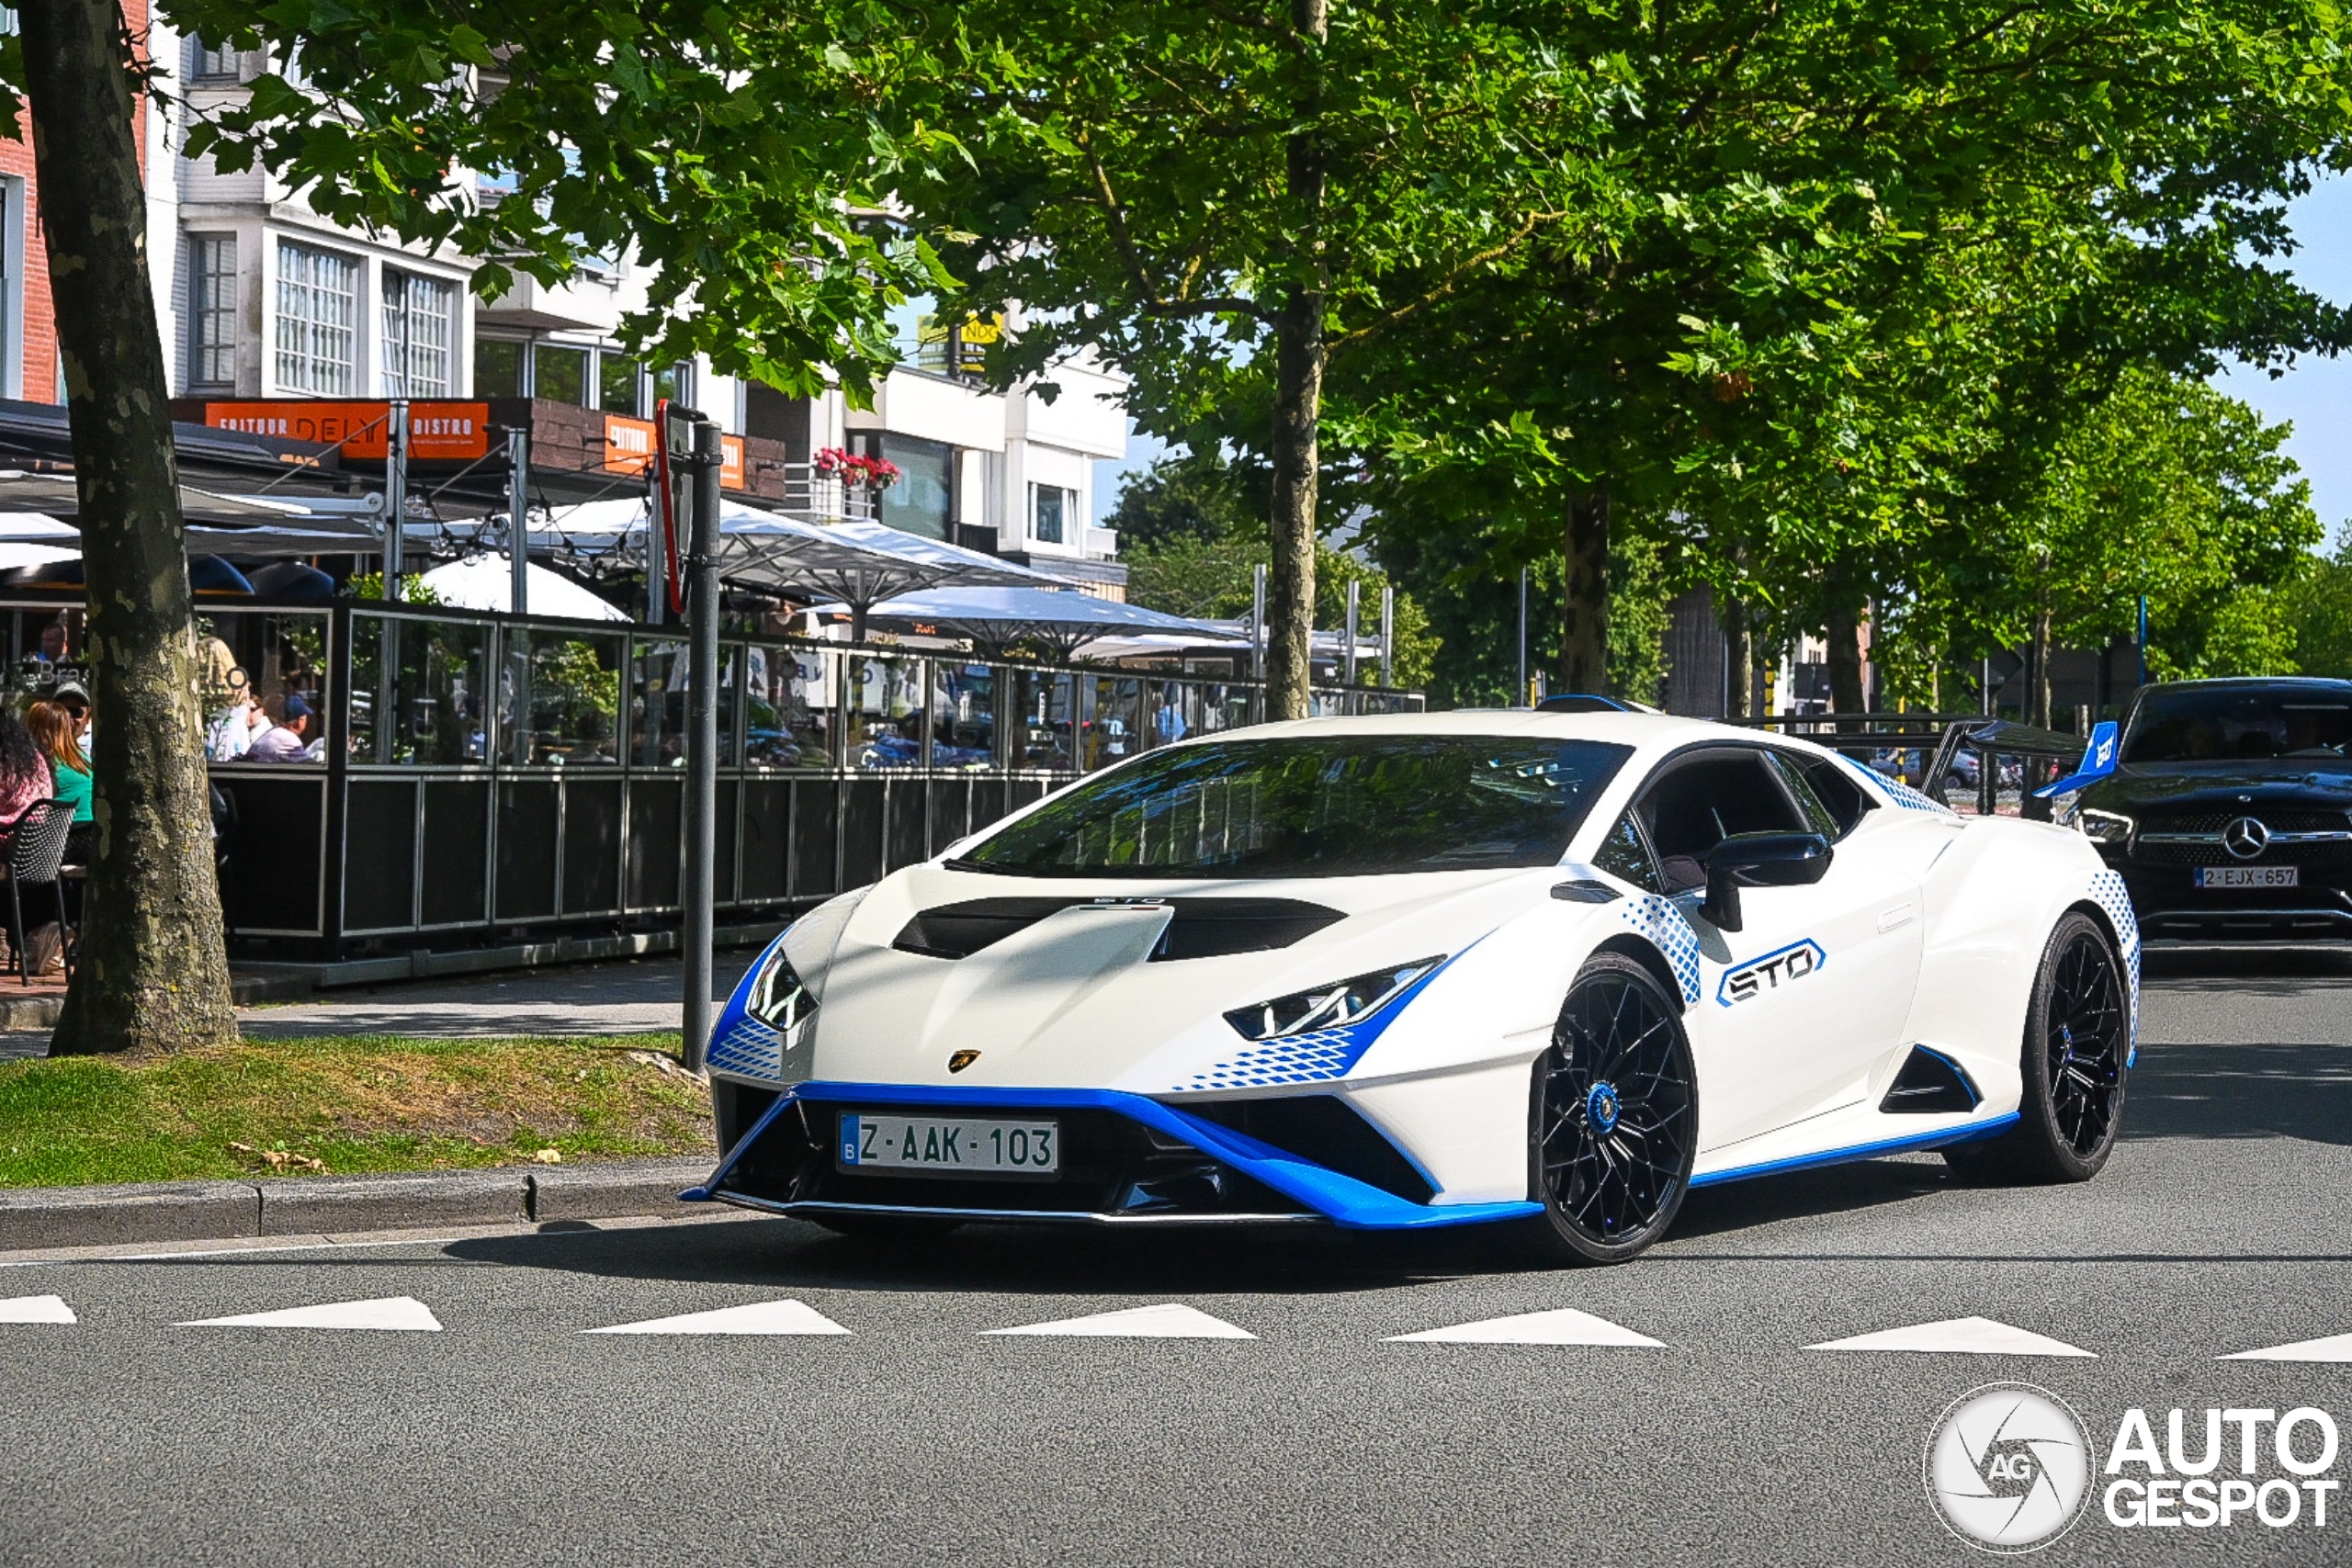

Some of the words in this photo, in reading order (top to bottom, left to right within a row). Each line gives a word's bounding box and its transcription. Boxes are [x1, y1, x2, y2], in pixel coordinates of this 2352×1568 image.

[413, 418, 471, 435] BISTRO
[1729, 948, 1813, 1002] STO
[844, 1143, 854, 1159] B
